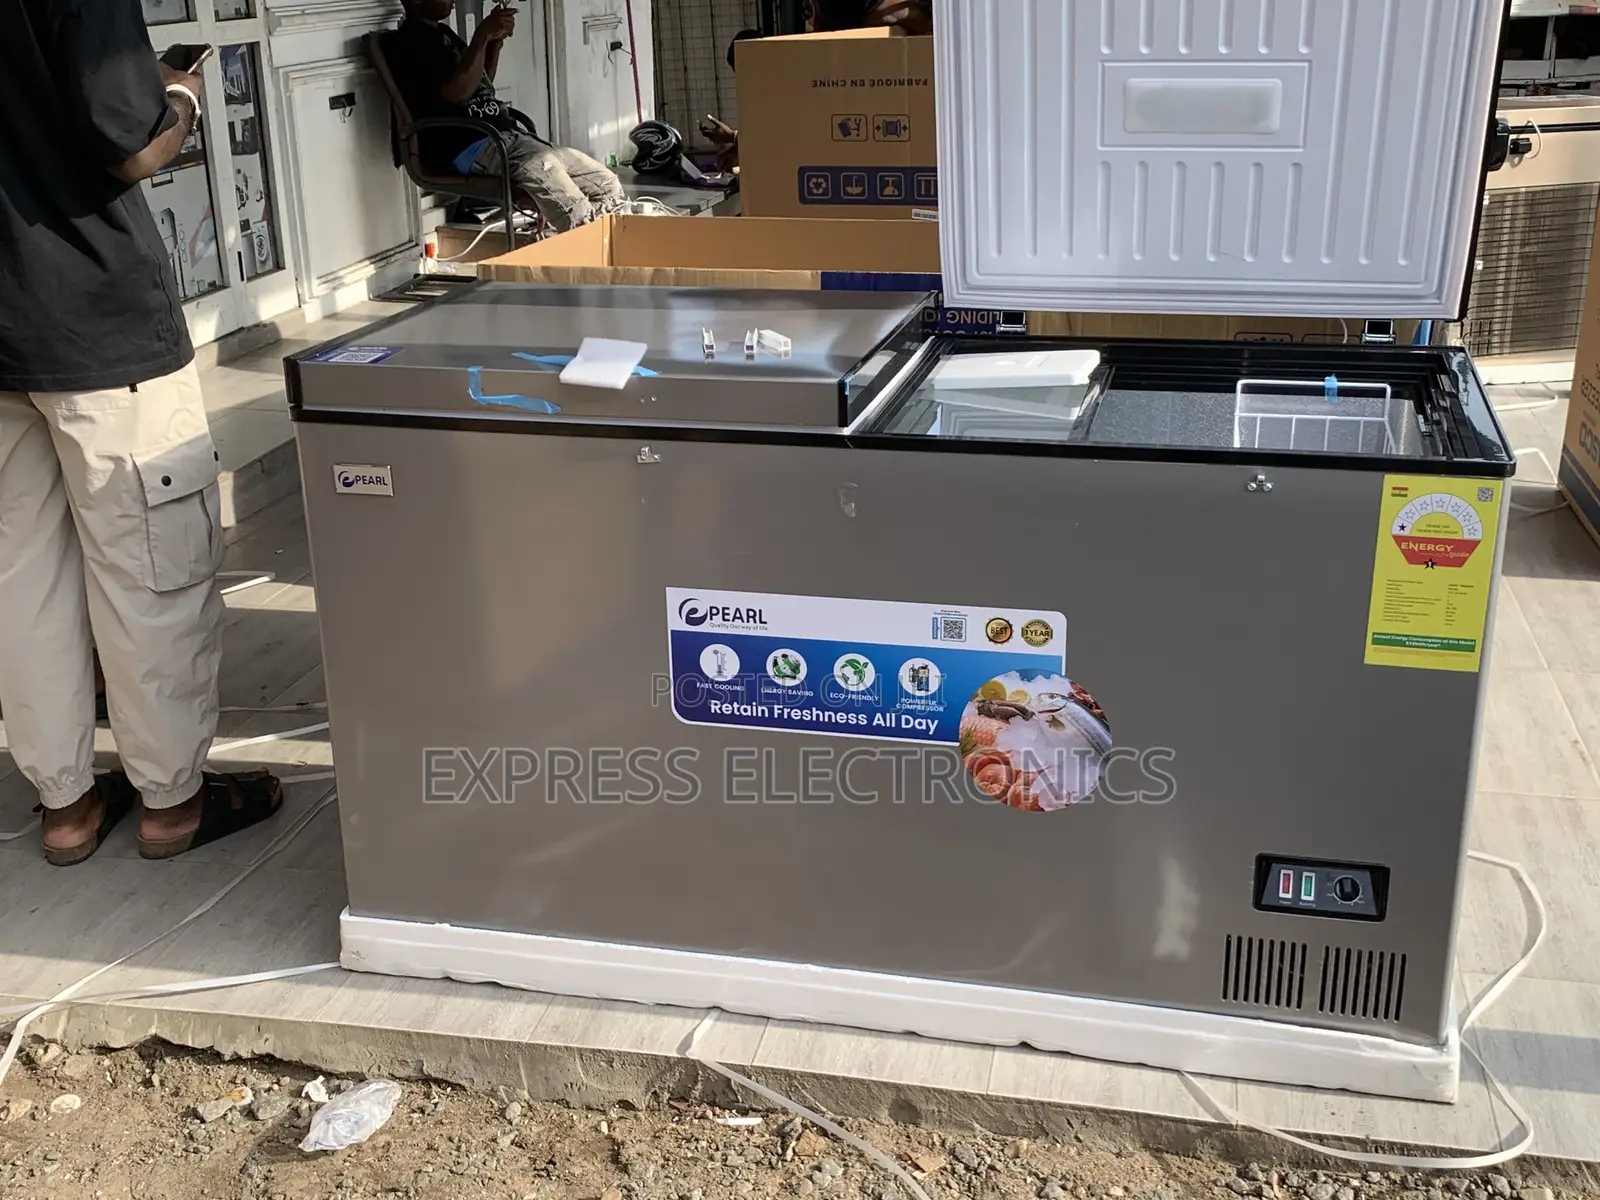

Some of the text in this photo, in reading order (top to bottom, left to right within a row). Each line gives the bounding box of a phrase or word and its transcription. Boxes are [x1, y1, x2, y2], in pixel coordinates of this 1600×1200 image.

[811, 78, 928, 89] FABRIQUÉ EN CHINE
[946, 310, 1000, 324] LIDING
[355, 475, 388, 486] PEARL
[1401, 541, 1454, 552] ENERGY
[1449, 551, 1470, 559] guide
[709, 605, 768, 624] PEARL
[990, 626, 1009, 636] BEST
[1029, 629, 1050, 637] YEAR
[696, 682, 745, 691] FAST COOLING
[760, 687, 814, 697] ENERGY SAVING
[829, 692, 880, 701] ECO-FRIENDLY
[895, 703, 945, 712] COMPRESSOR
[710, 699, 939, 735] Retain Freshness All Day
